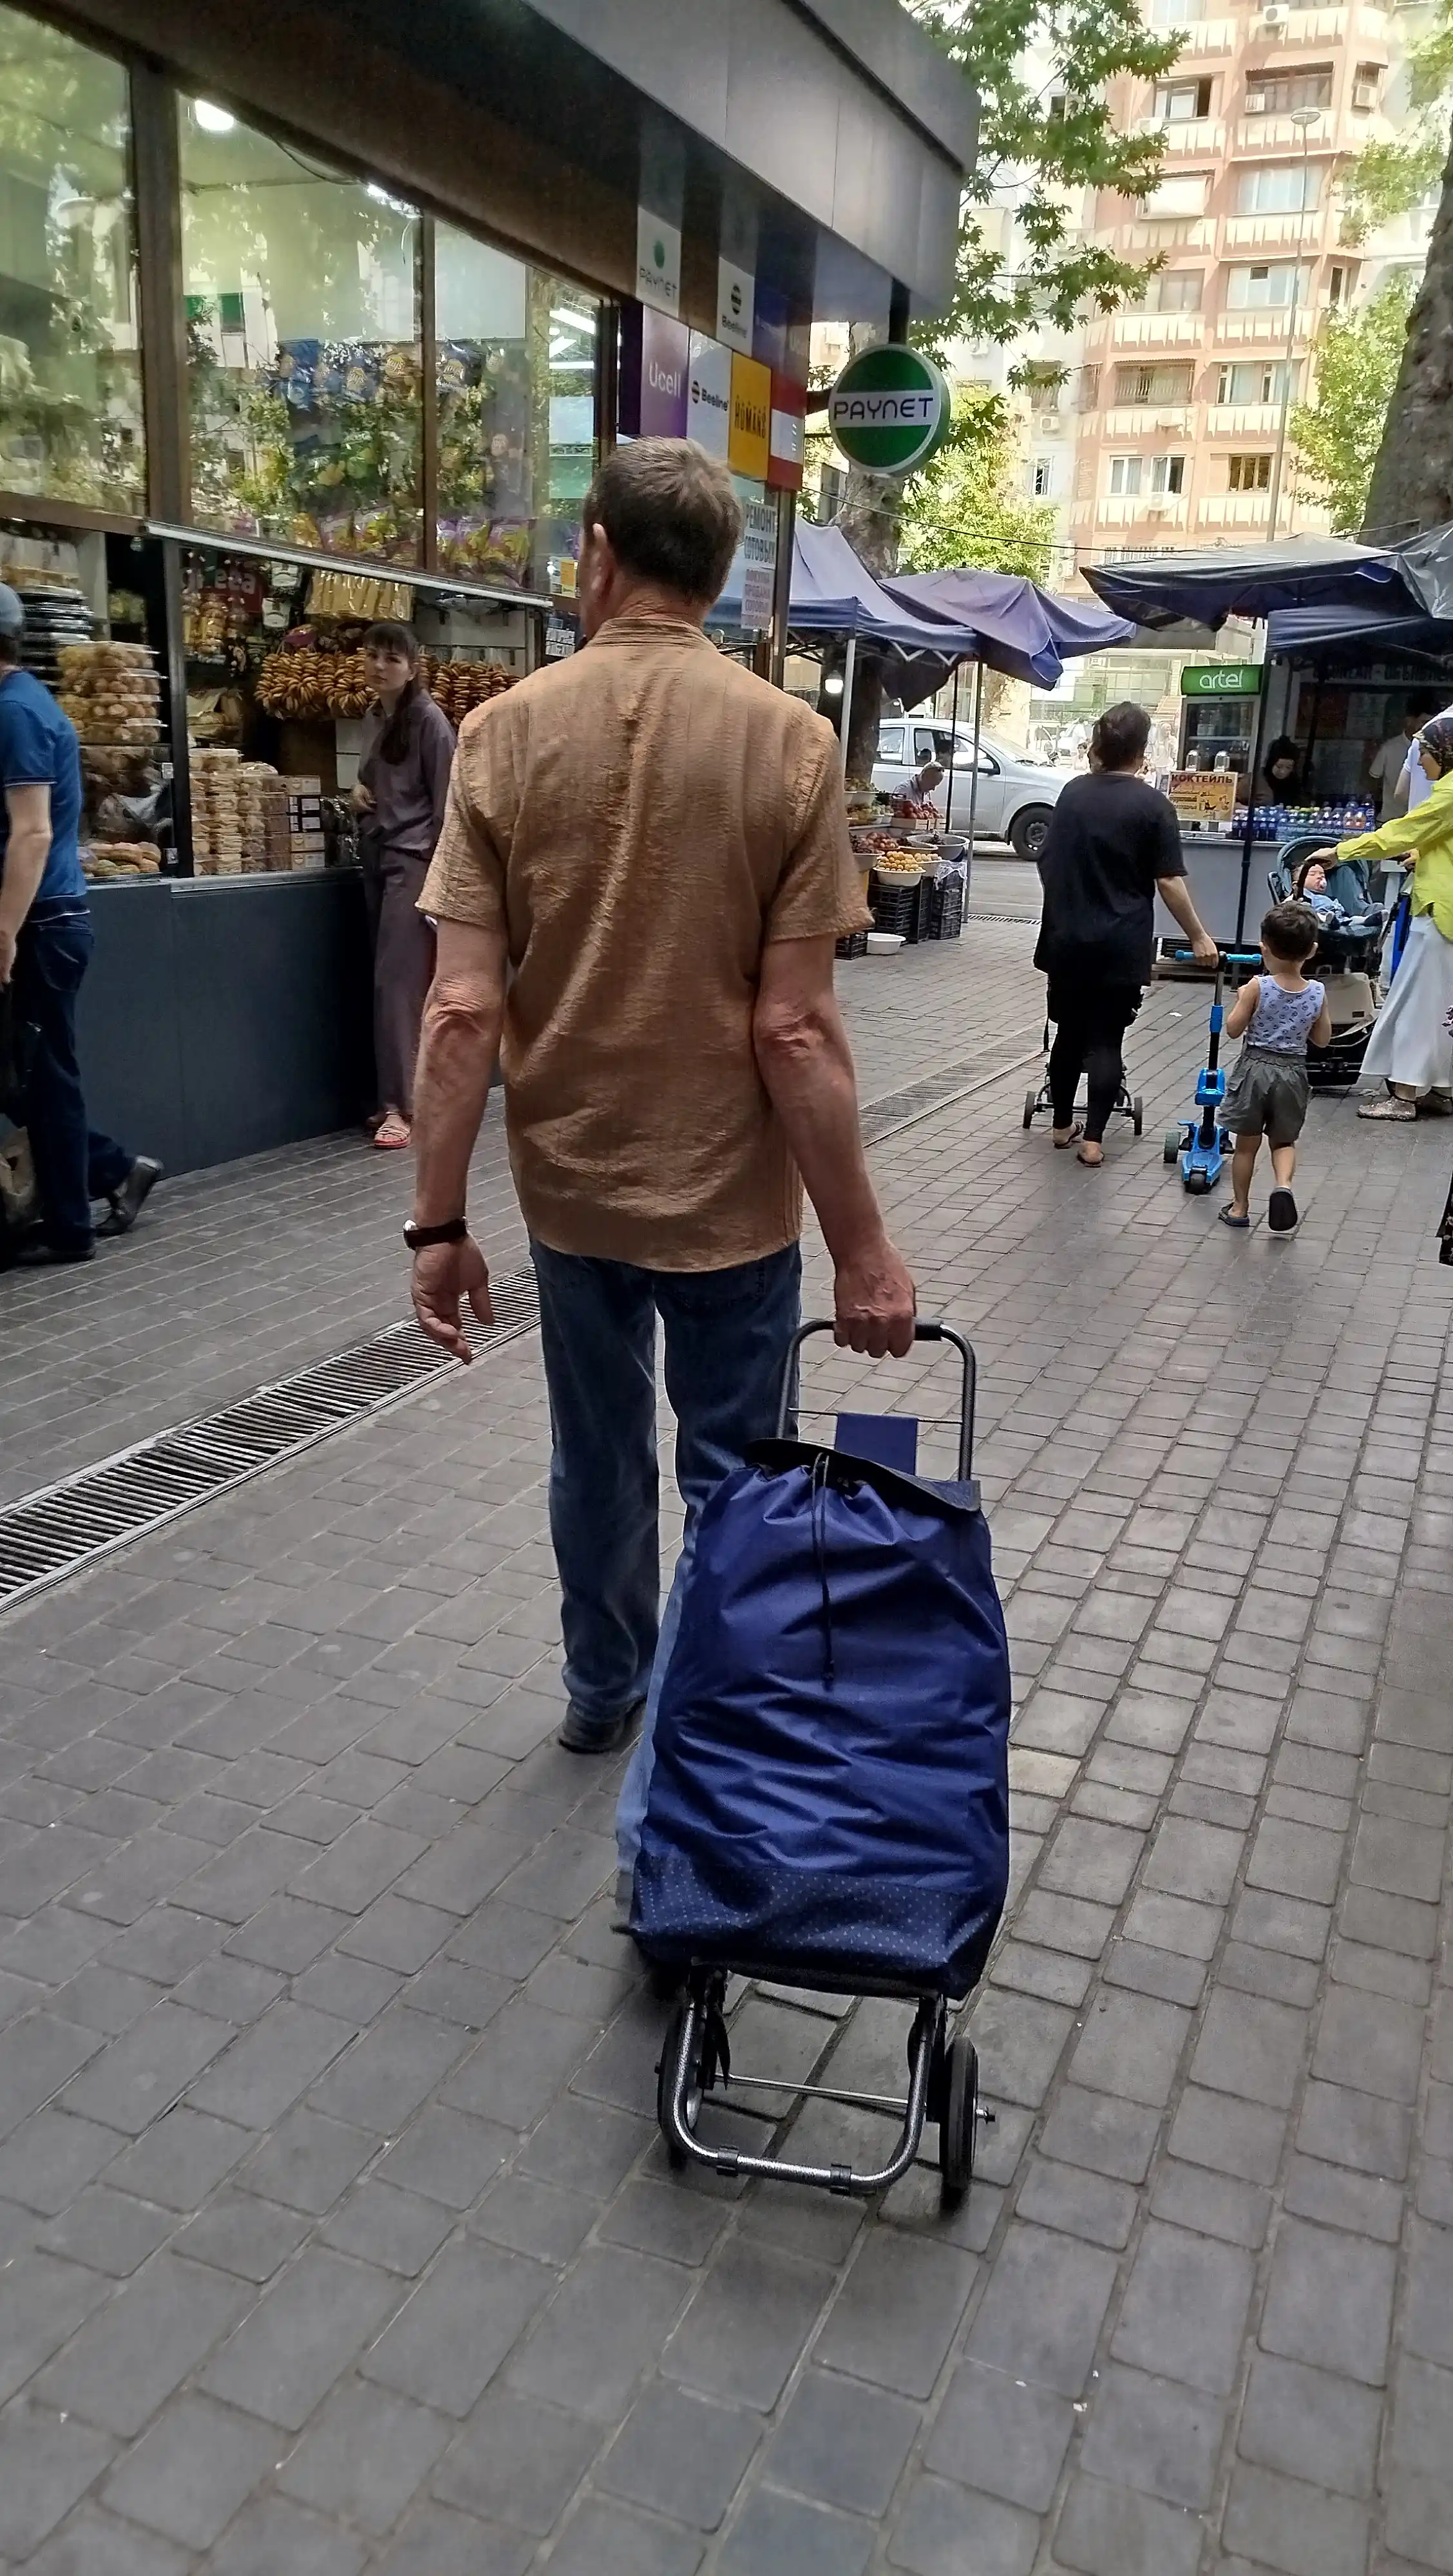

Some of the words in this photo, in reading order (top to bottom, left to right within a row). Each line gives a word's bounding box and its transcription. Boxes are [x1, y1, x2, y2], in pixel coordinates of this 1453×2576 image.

[649, 361, 681, 398] Ucell
[701, 388, 728, 412] Beeline
[834, 397, 934, 420] PAYNET
[1200, 670, 1244, 688] artel
